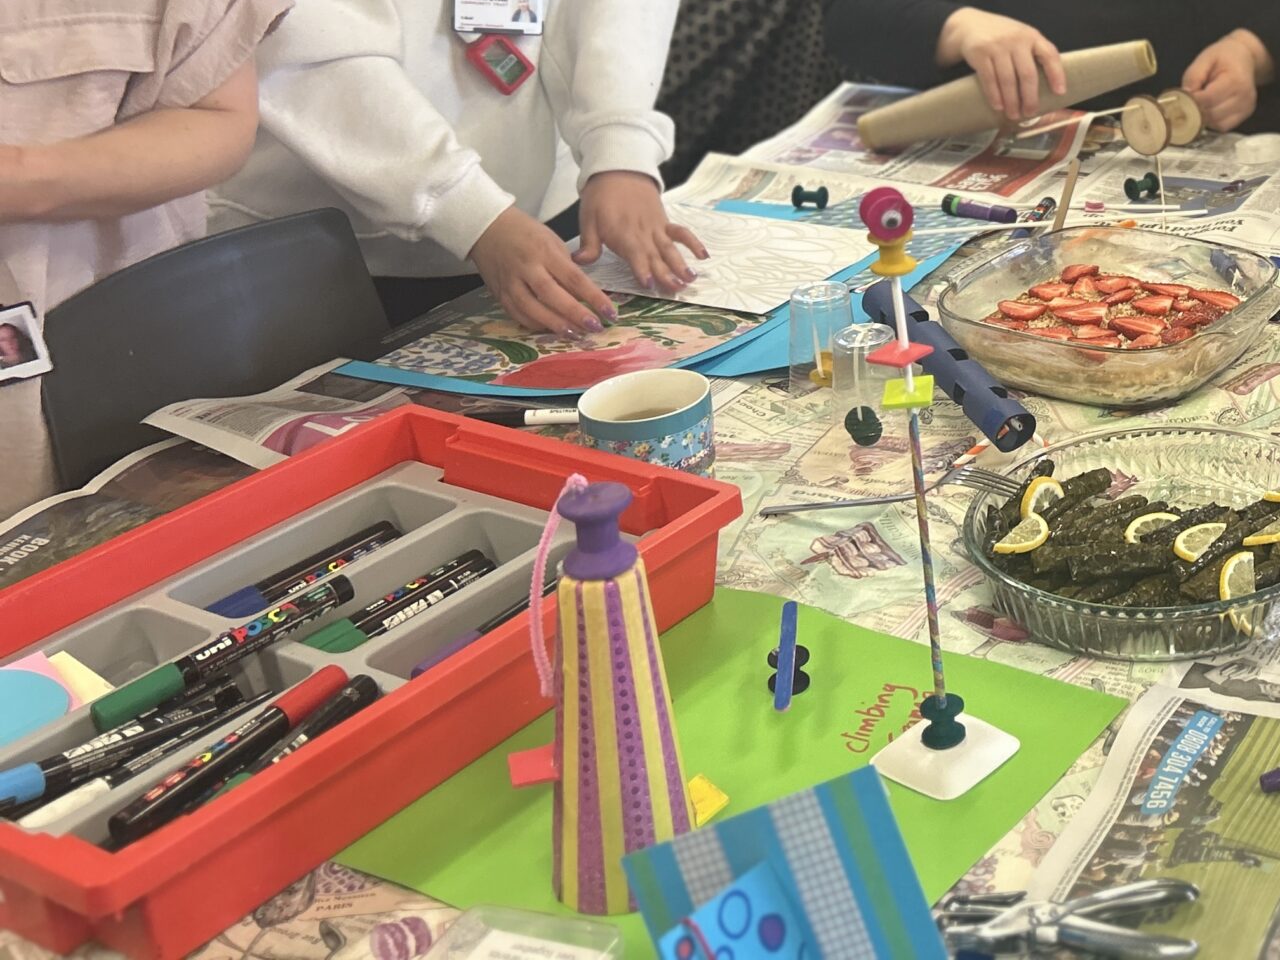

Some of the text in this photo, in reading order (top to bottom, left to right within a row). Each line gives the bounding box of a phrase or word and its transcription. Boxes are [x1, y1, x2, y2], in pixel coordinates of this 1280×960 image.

[1, 537, 50, 567] BOOK
[196, 636, 233, 661] uni
[1176, 728, 1209, 755] 0808
[1162, 751, 1192, 774] 304
[1146, 775, 1180, 809] 7456
